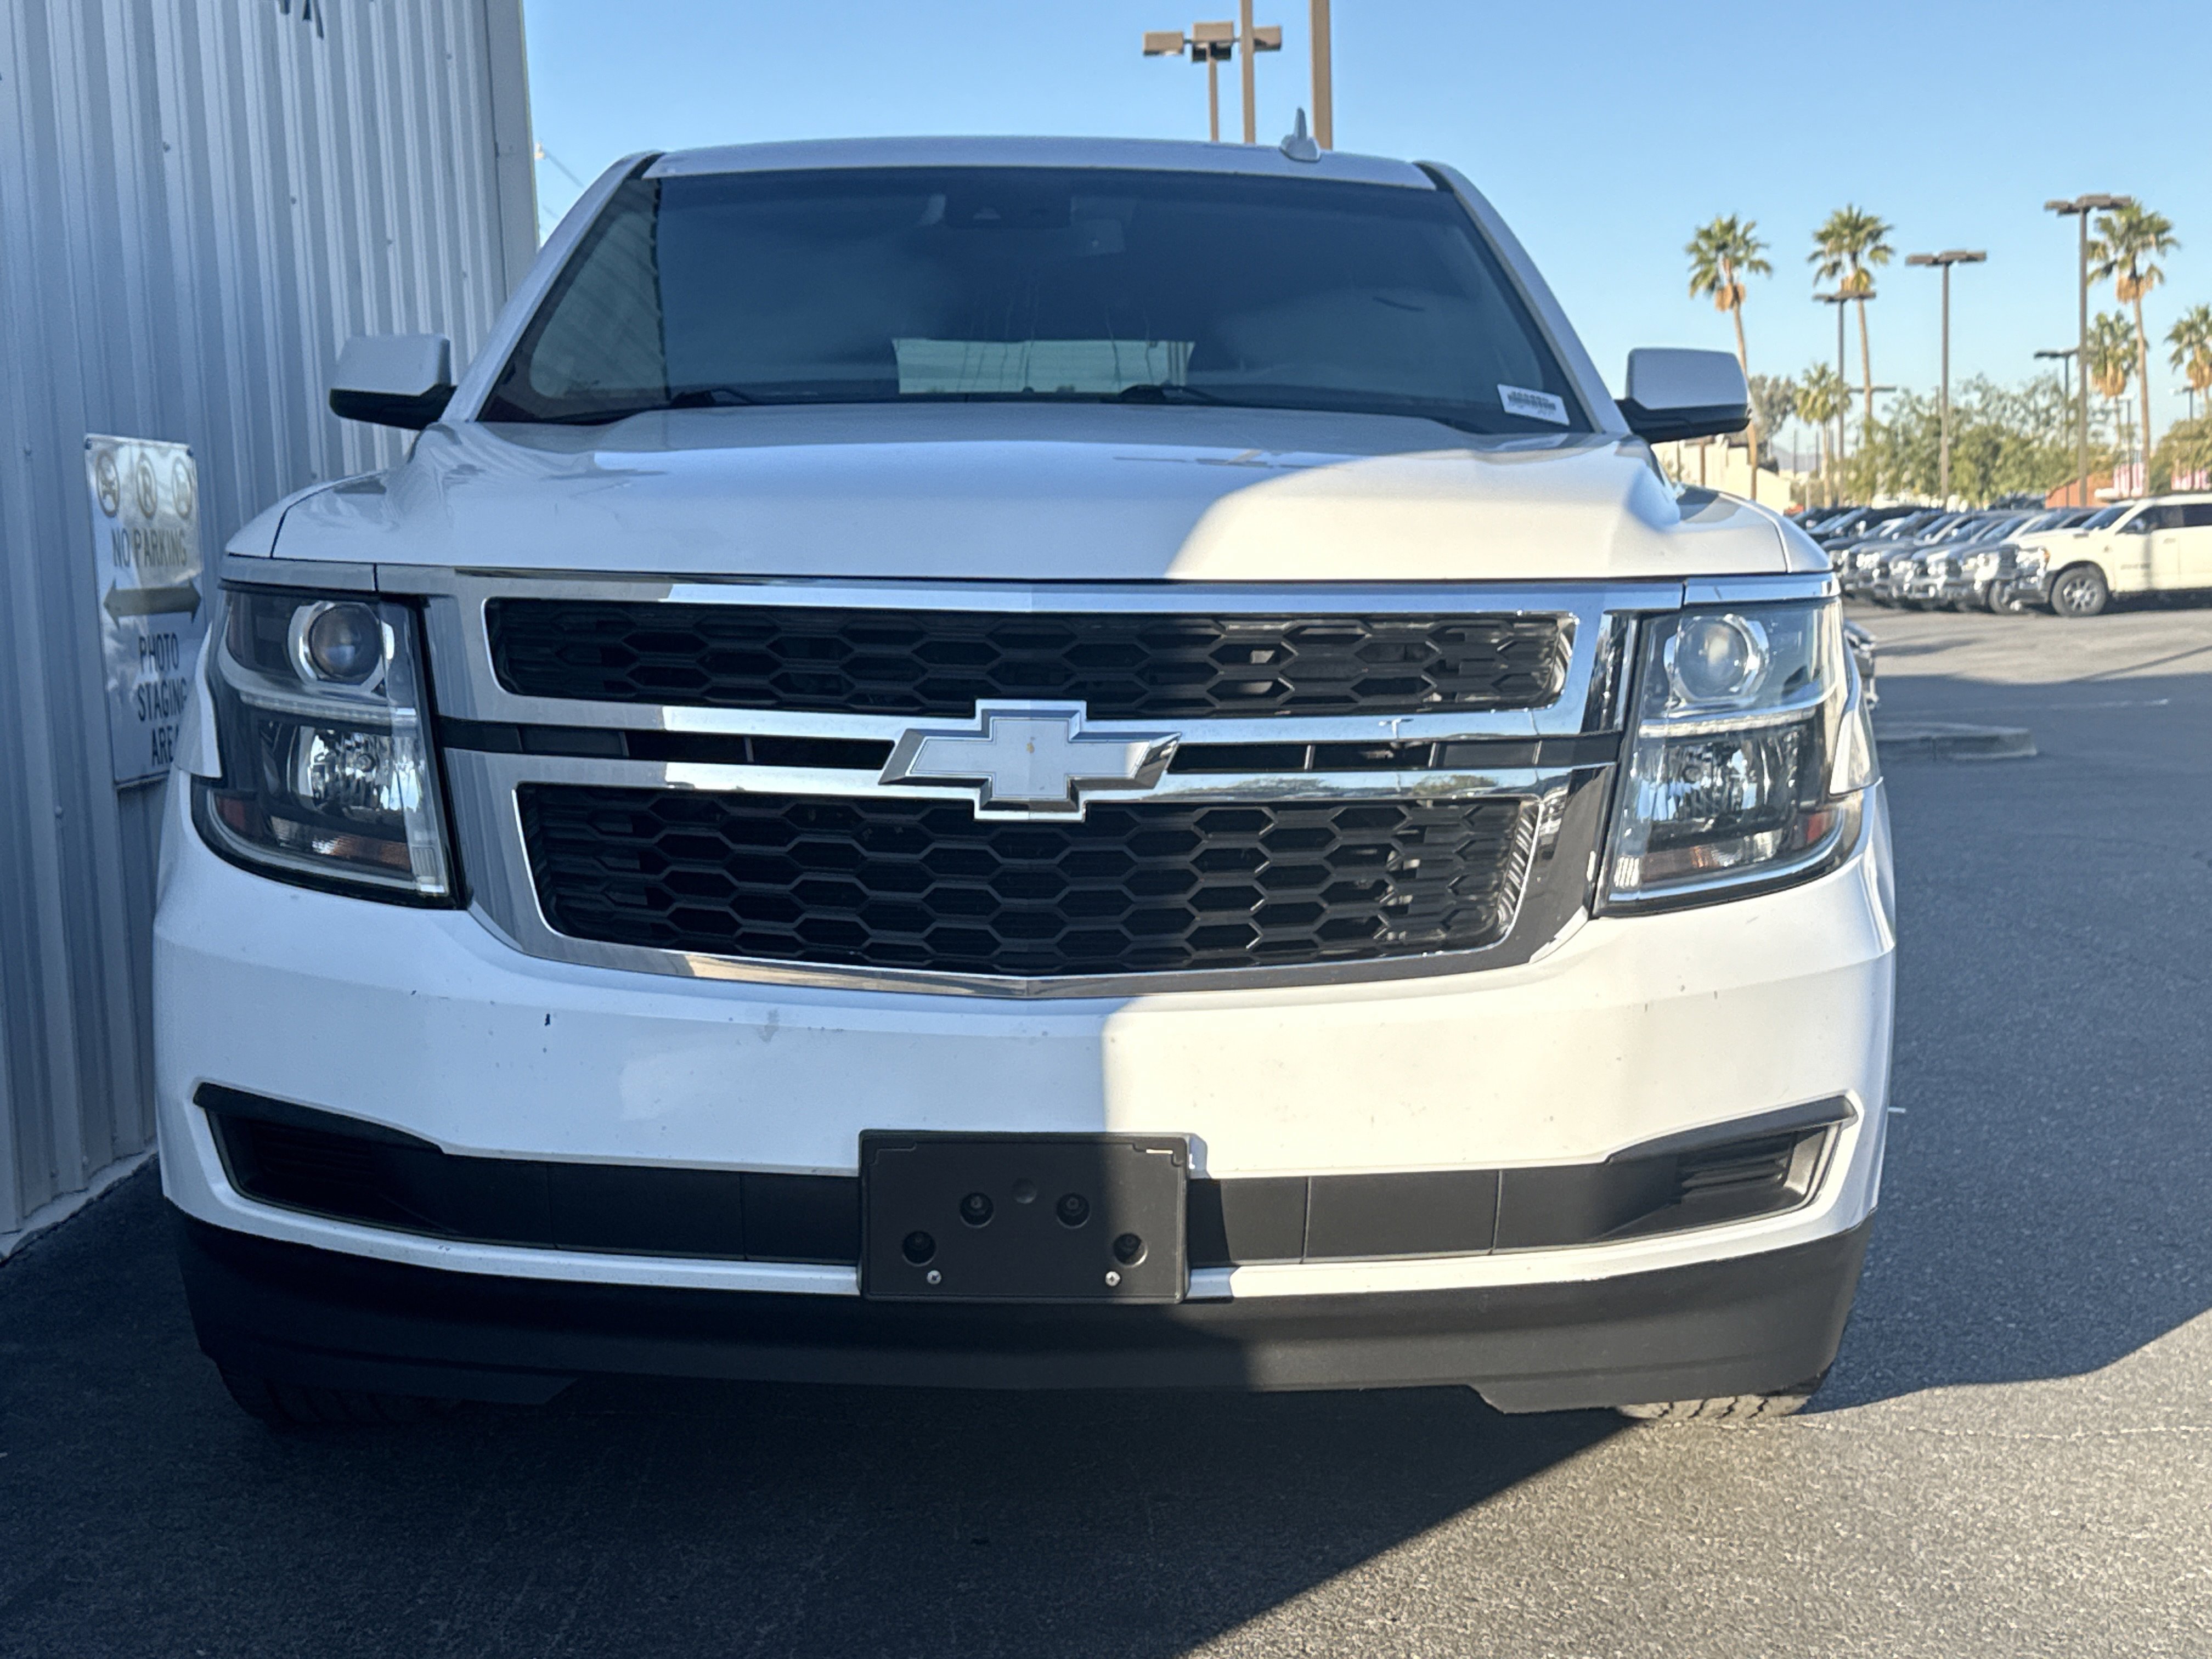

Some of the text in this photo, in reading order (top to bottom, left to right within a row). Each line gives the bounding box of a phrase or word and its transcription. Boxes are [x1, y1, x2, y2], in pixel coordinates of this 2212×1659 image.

[111, 527, 187, 568] NO PARKING
[139, 632, 179, 675] PHOTO
